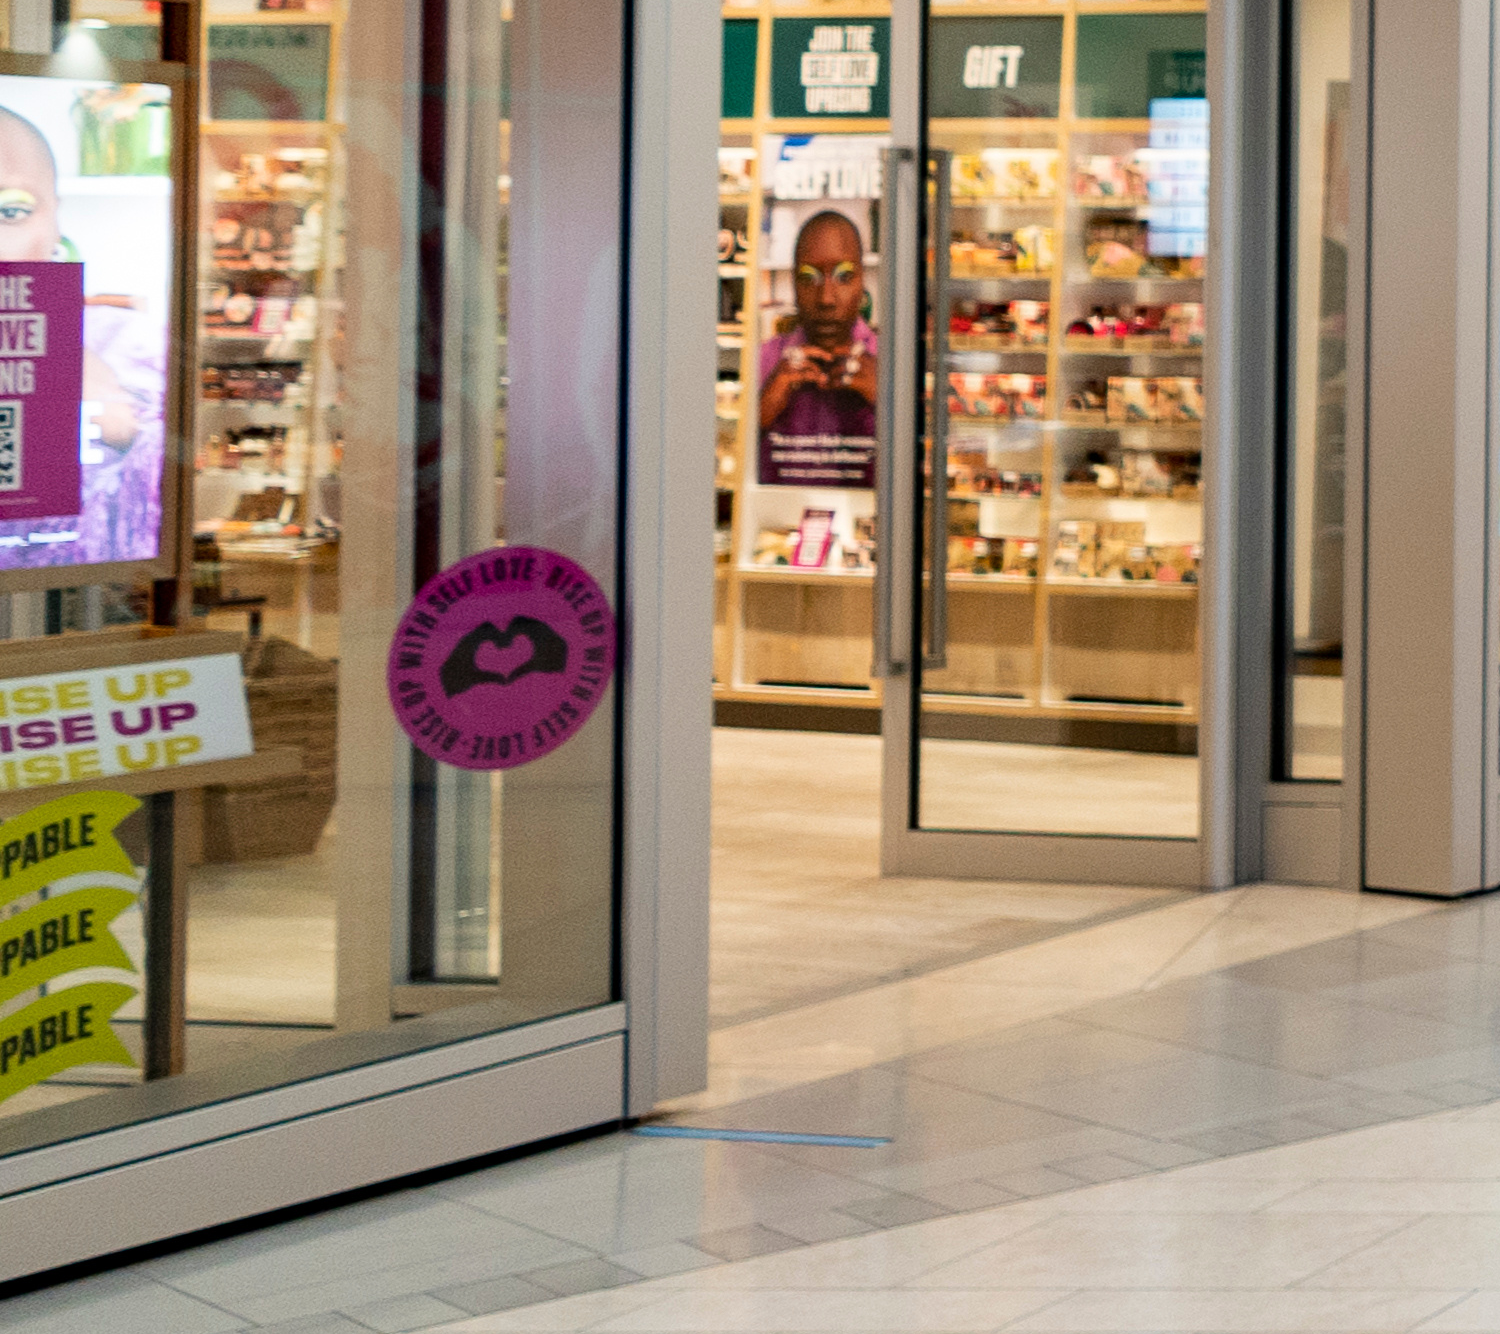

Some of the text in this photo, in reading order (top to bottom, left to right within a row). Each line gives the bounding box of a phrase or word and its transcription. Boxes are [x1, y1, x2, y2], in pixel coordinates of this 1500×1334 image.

[845, 25, 874, 52] THE
[963, 45, 1024, 88] GIFT
[397, 609, 438, 670] WITH
[426, 568, 474, 615] SELF
[478, 556, 538, 586] LOVE
[104, 669, 192, 703] UP
[110, 703, 197, 737] UP
[115, 735, 203, 772] UP
[3, 813, 97, 879] PABLE
[1, 908, 95, 976] PABLE
